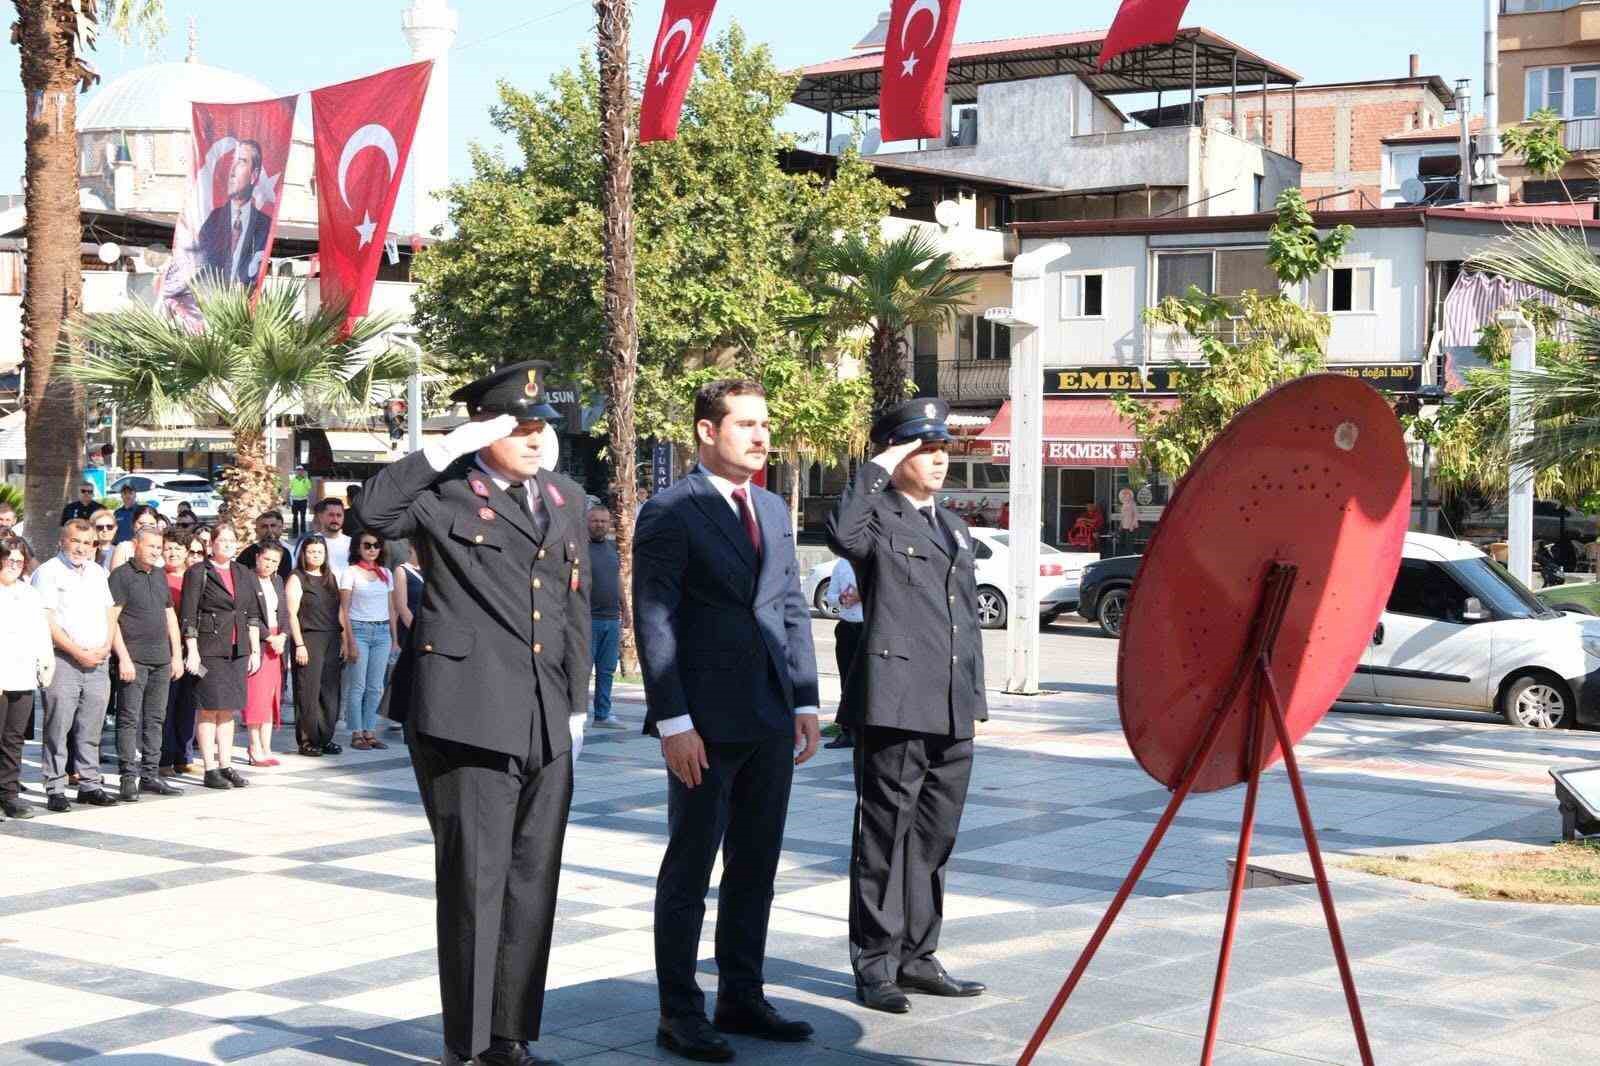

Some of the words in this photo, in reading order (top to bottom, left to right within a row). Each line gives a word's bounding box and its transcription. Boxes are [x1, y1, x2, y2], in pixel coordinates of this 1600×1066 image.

[1058, 371, 1157, 390] EMEK
[1361, 367, 1387, 379] doğal
[1390, 366, 1414, 380] hali)
[543, 391, 575, 403] LSUN
[1048, 443, 1117, 459] EKMEK
